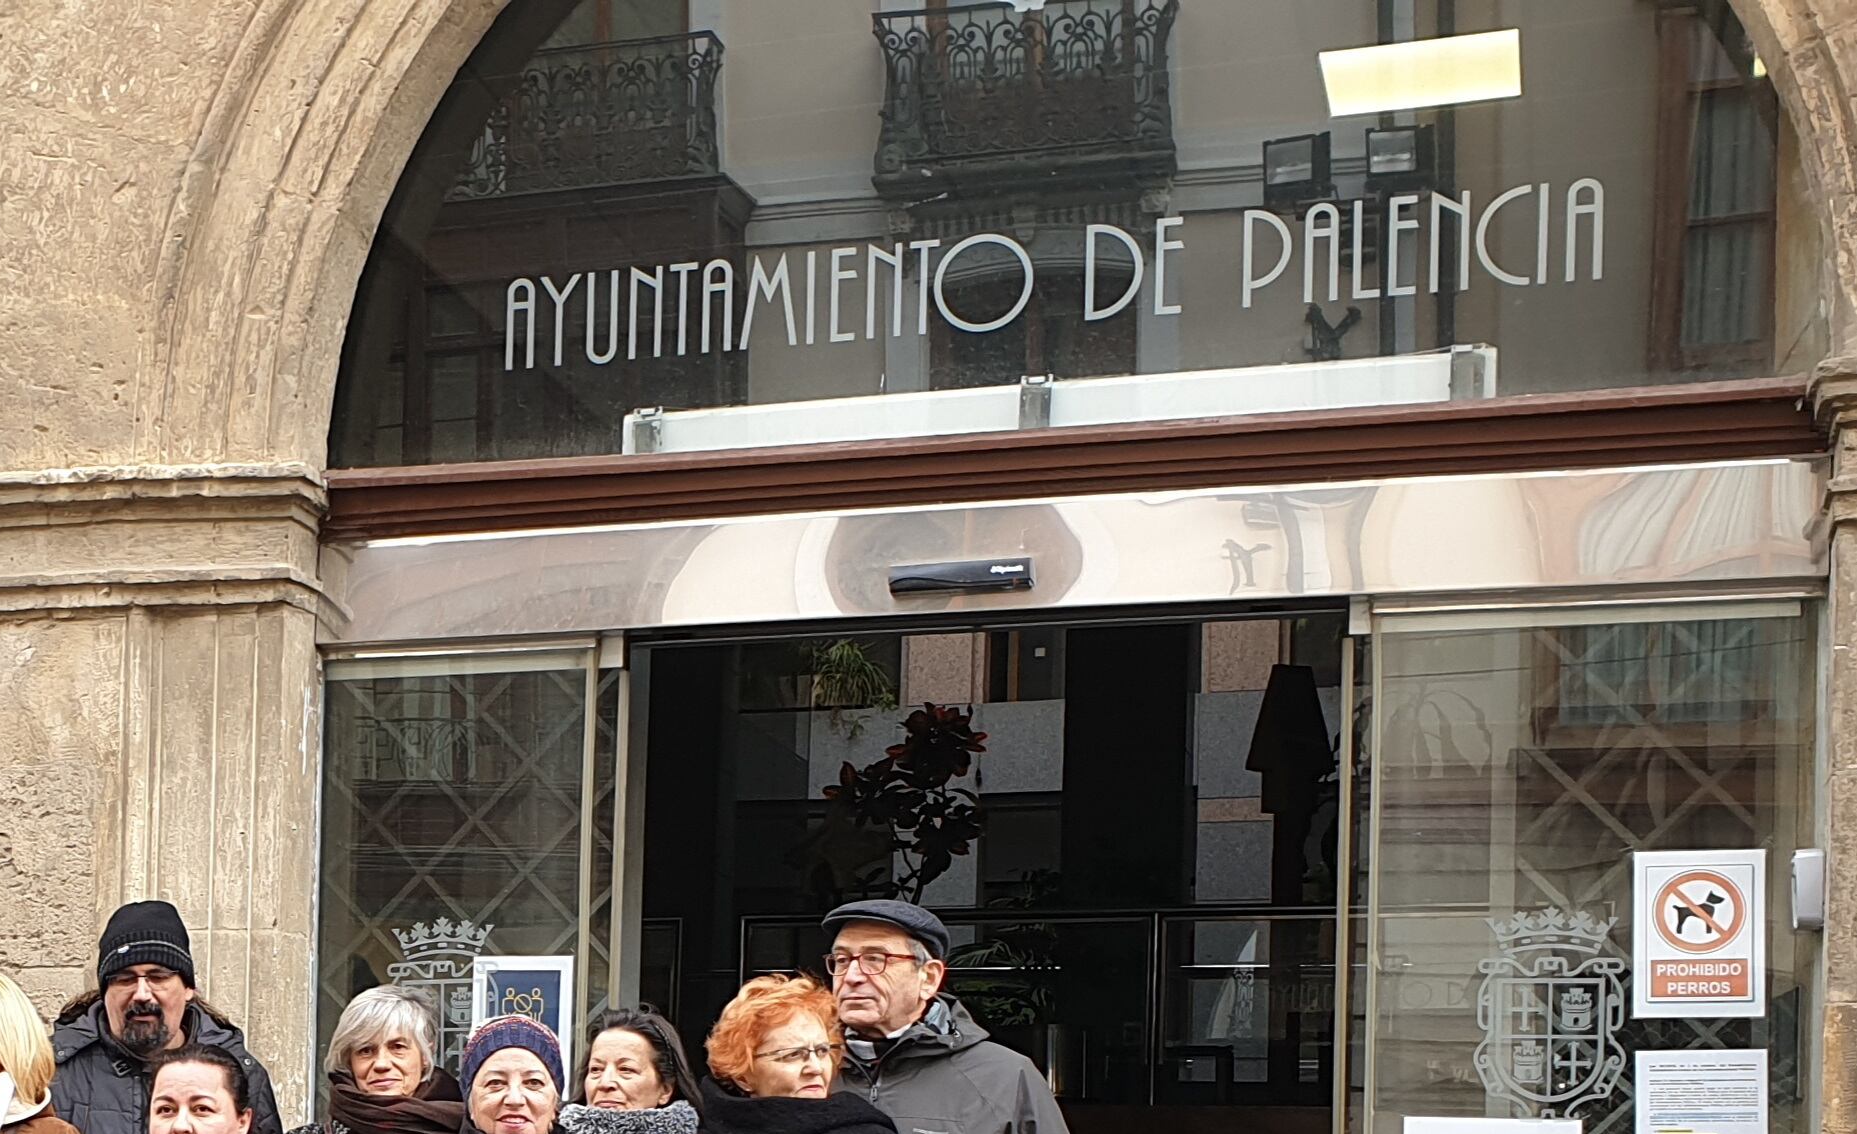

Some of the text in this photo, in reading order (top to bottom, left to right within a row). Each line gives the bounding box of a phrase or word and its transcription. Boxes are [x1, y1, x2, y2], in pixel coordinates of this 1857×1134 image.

[505, 178, 1604, 371] AYUNTAMIENTO DE PALENCIA
[1656, 963, 1742, 977] PROHIBIDO
[1667, 981, 1731, 995] PERROS
